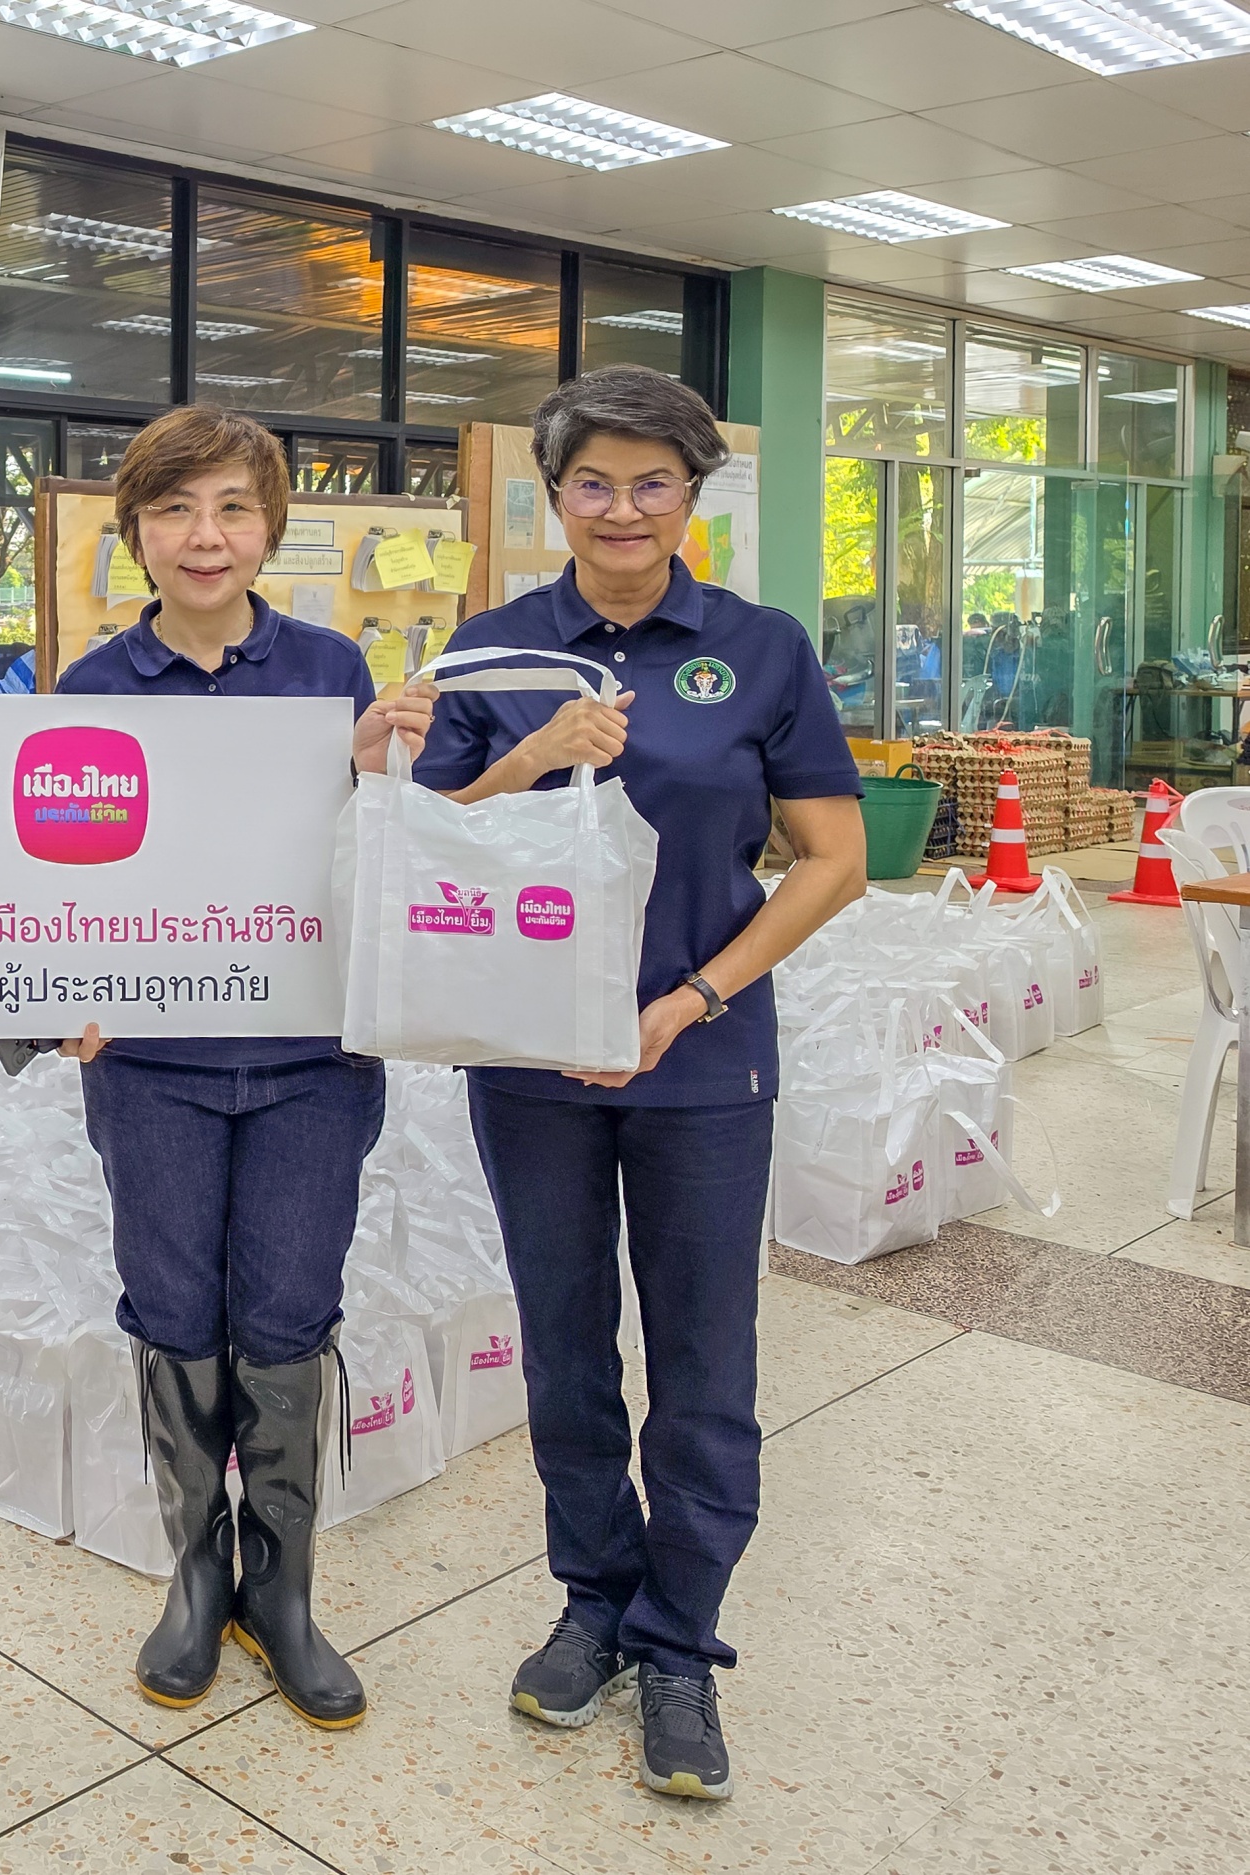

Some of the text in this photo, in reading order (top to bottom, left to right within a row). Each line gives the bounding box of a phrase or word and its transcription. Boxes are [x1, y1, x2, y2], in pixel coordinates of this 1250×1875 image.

[23, 763, 139, 798] เมืองไทย
[34, 802, 129, 823] ประกันชีวิต
[519, 899, 571, 916] เมืองไทย
